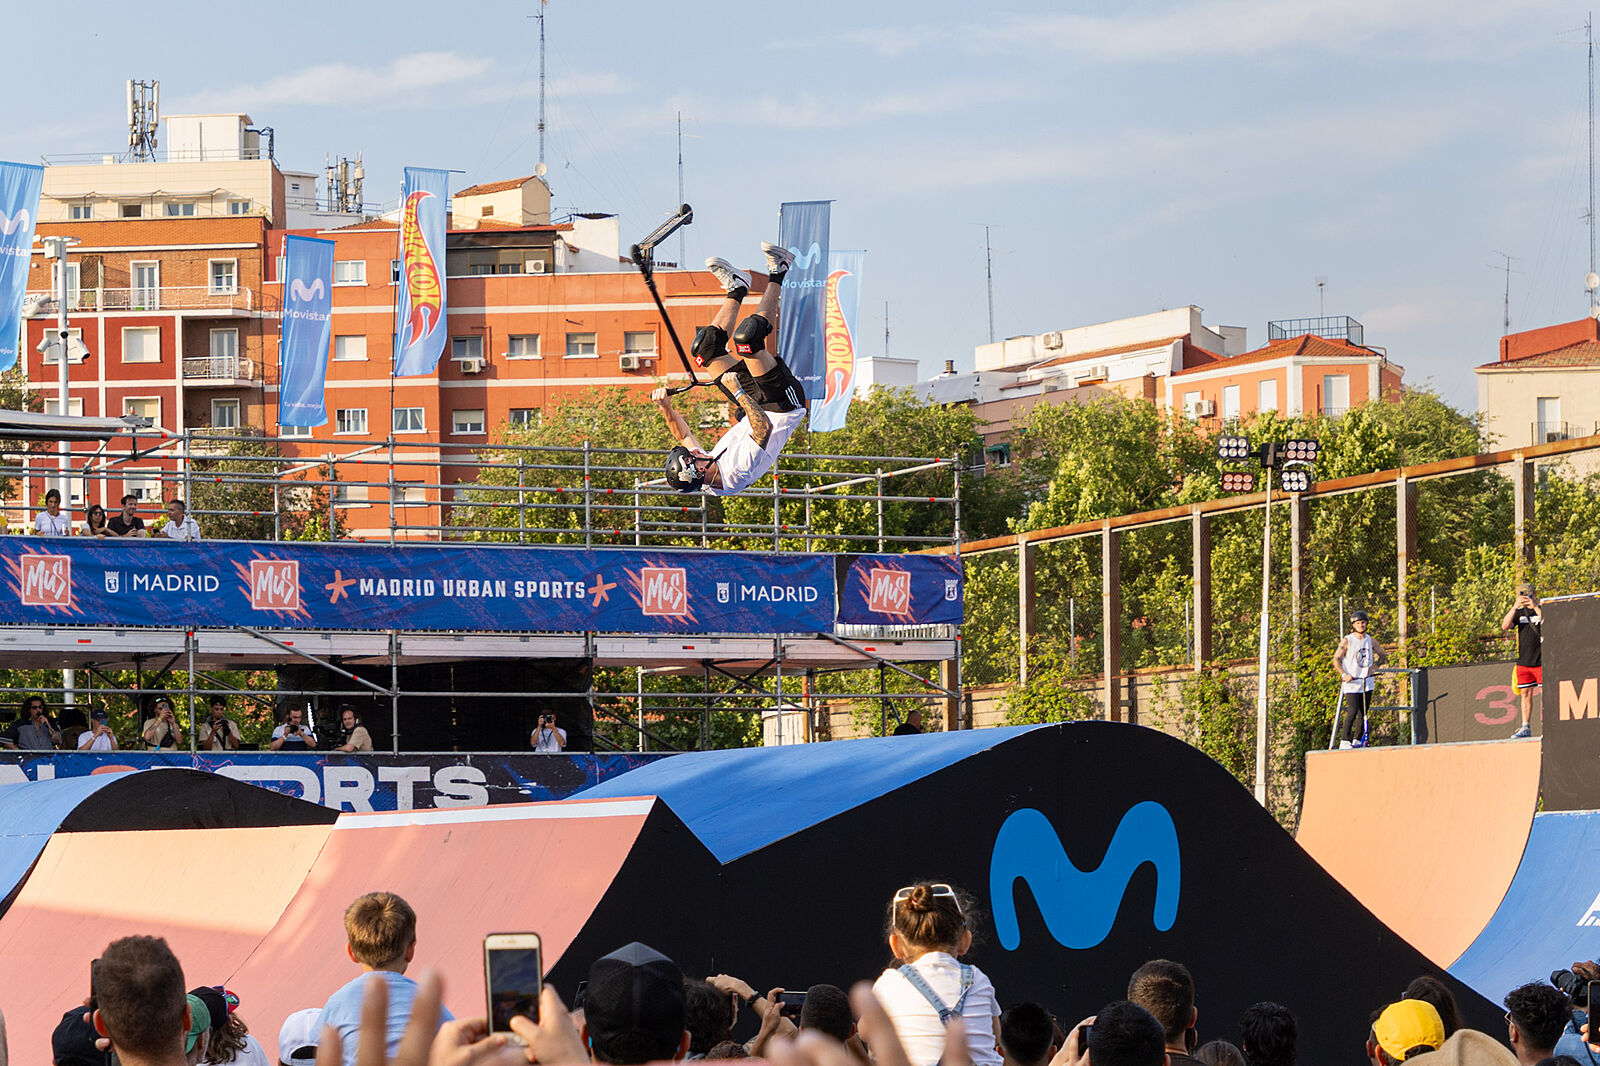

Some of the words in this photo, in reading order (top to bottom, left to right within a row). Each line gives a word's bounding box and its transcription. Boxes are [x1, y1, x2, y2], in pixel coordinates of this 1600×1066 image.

[0, 244, 31, 256] vistar
[781, 278, 828, 289] Movistar
[284, 308, 331, 321] Movistar
[132, 573, 219, 592] MADRID
[359, 578, 435, 597] MADRID
[443, 579, 506, 598] URBAN
[514, 580, 585, 599] SPORTS
[741, 585, 818, 602] MADRID
[1559, 678, 1600, 720] M
